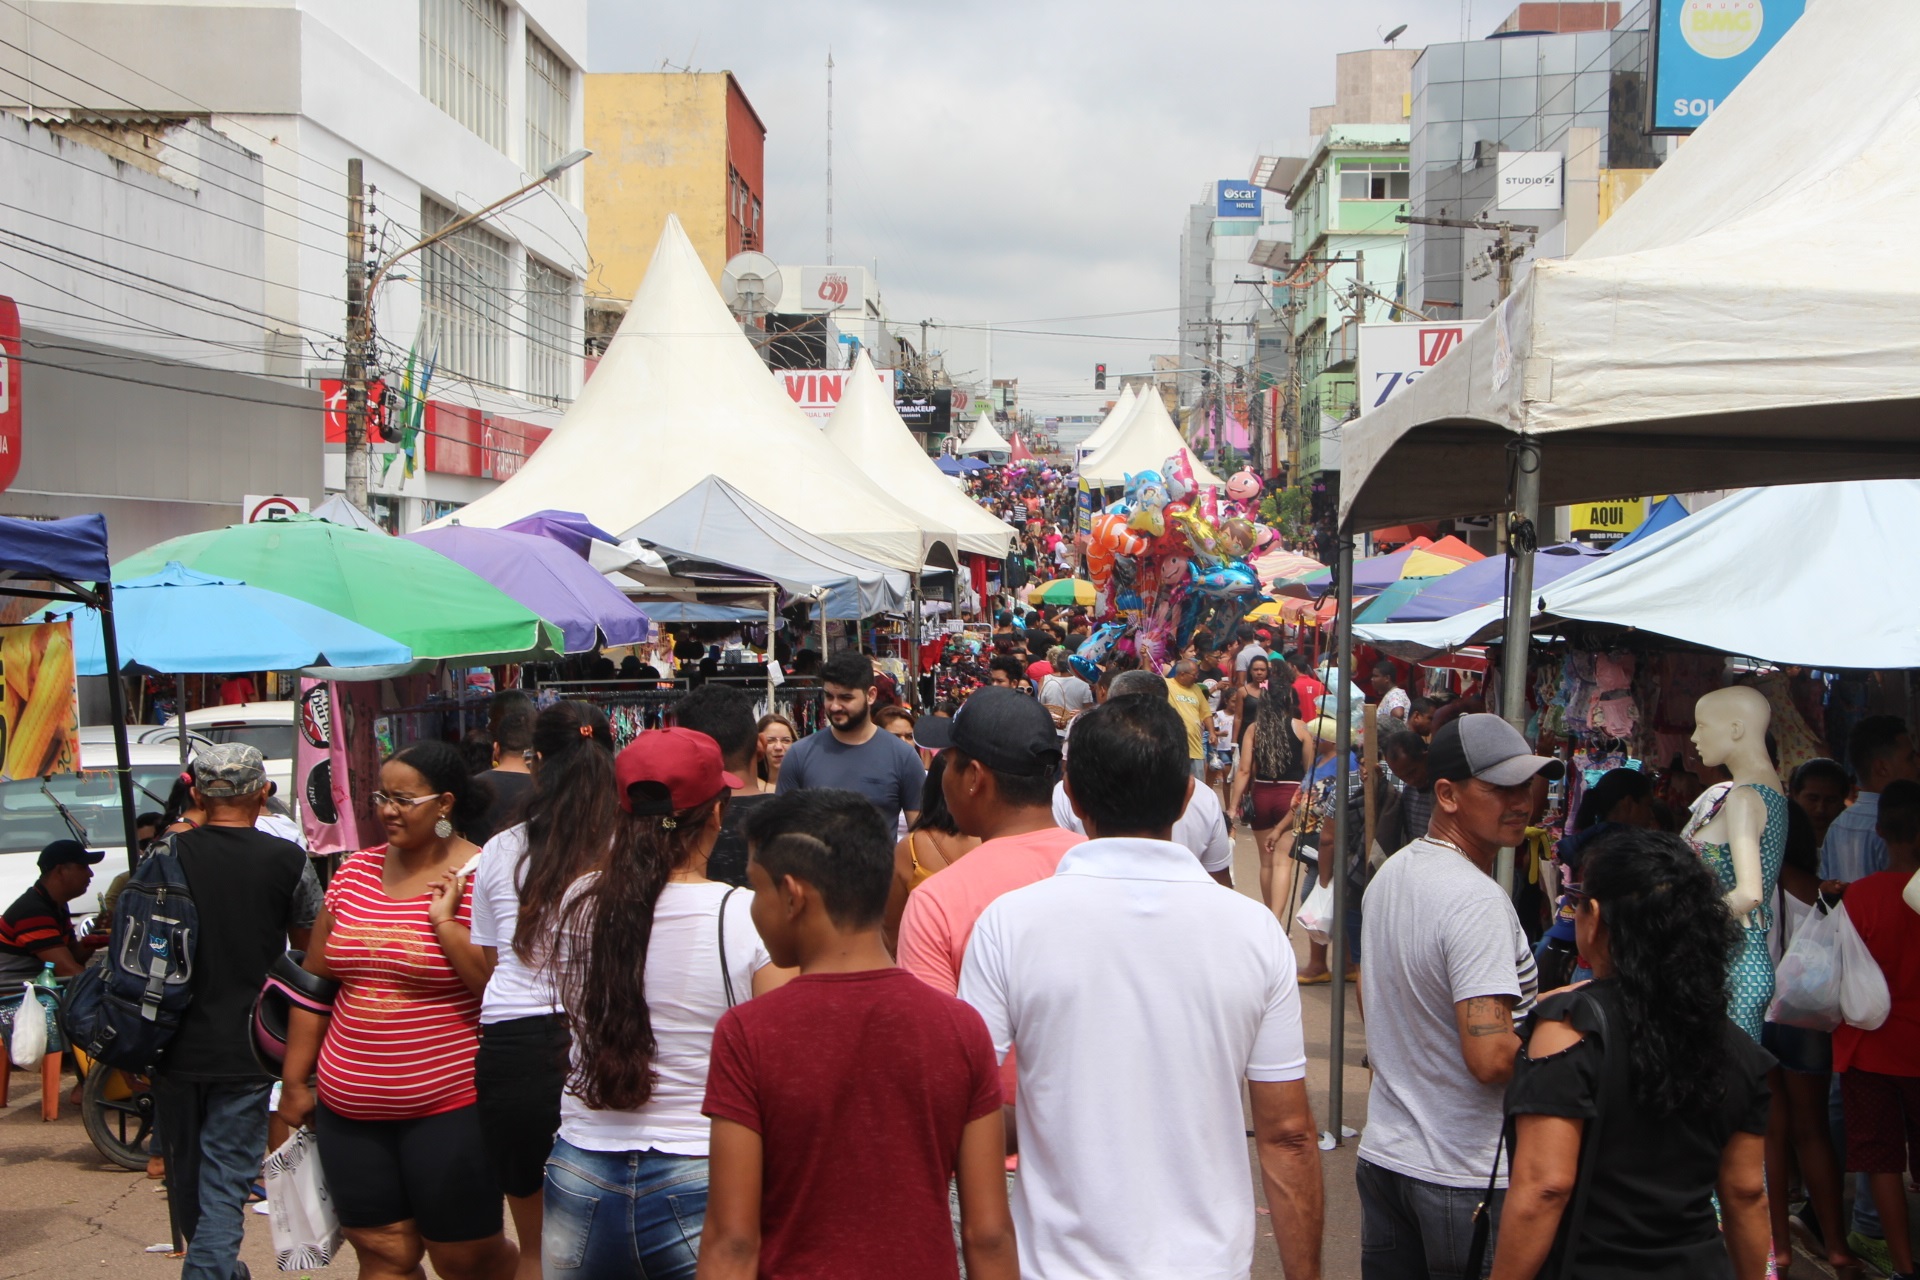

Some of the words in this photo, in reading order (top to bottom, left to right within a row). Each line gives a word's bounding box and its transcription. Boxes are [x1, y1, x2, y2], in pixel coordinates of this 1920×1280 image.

[1691, 10, 1752, 32] BMG
[1505, 177, 1543, 185] STUDIO
[1224, 188, 1257, 199] Oscar
[1590, 506, 1624, 526] AQUI
